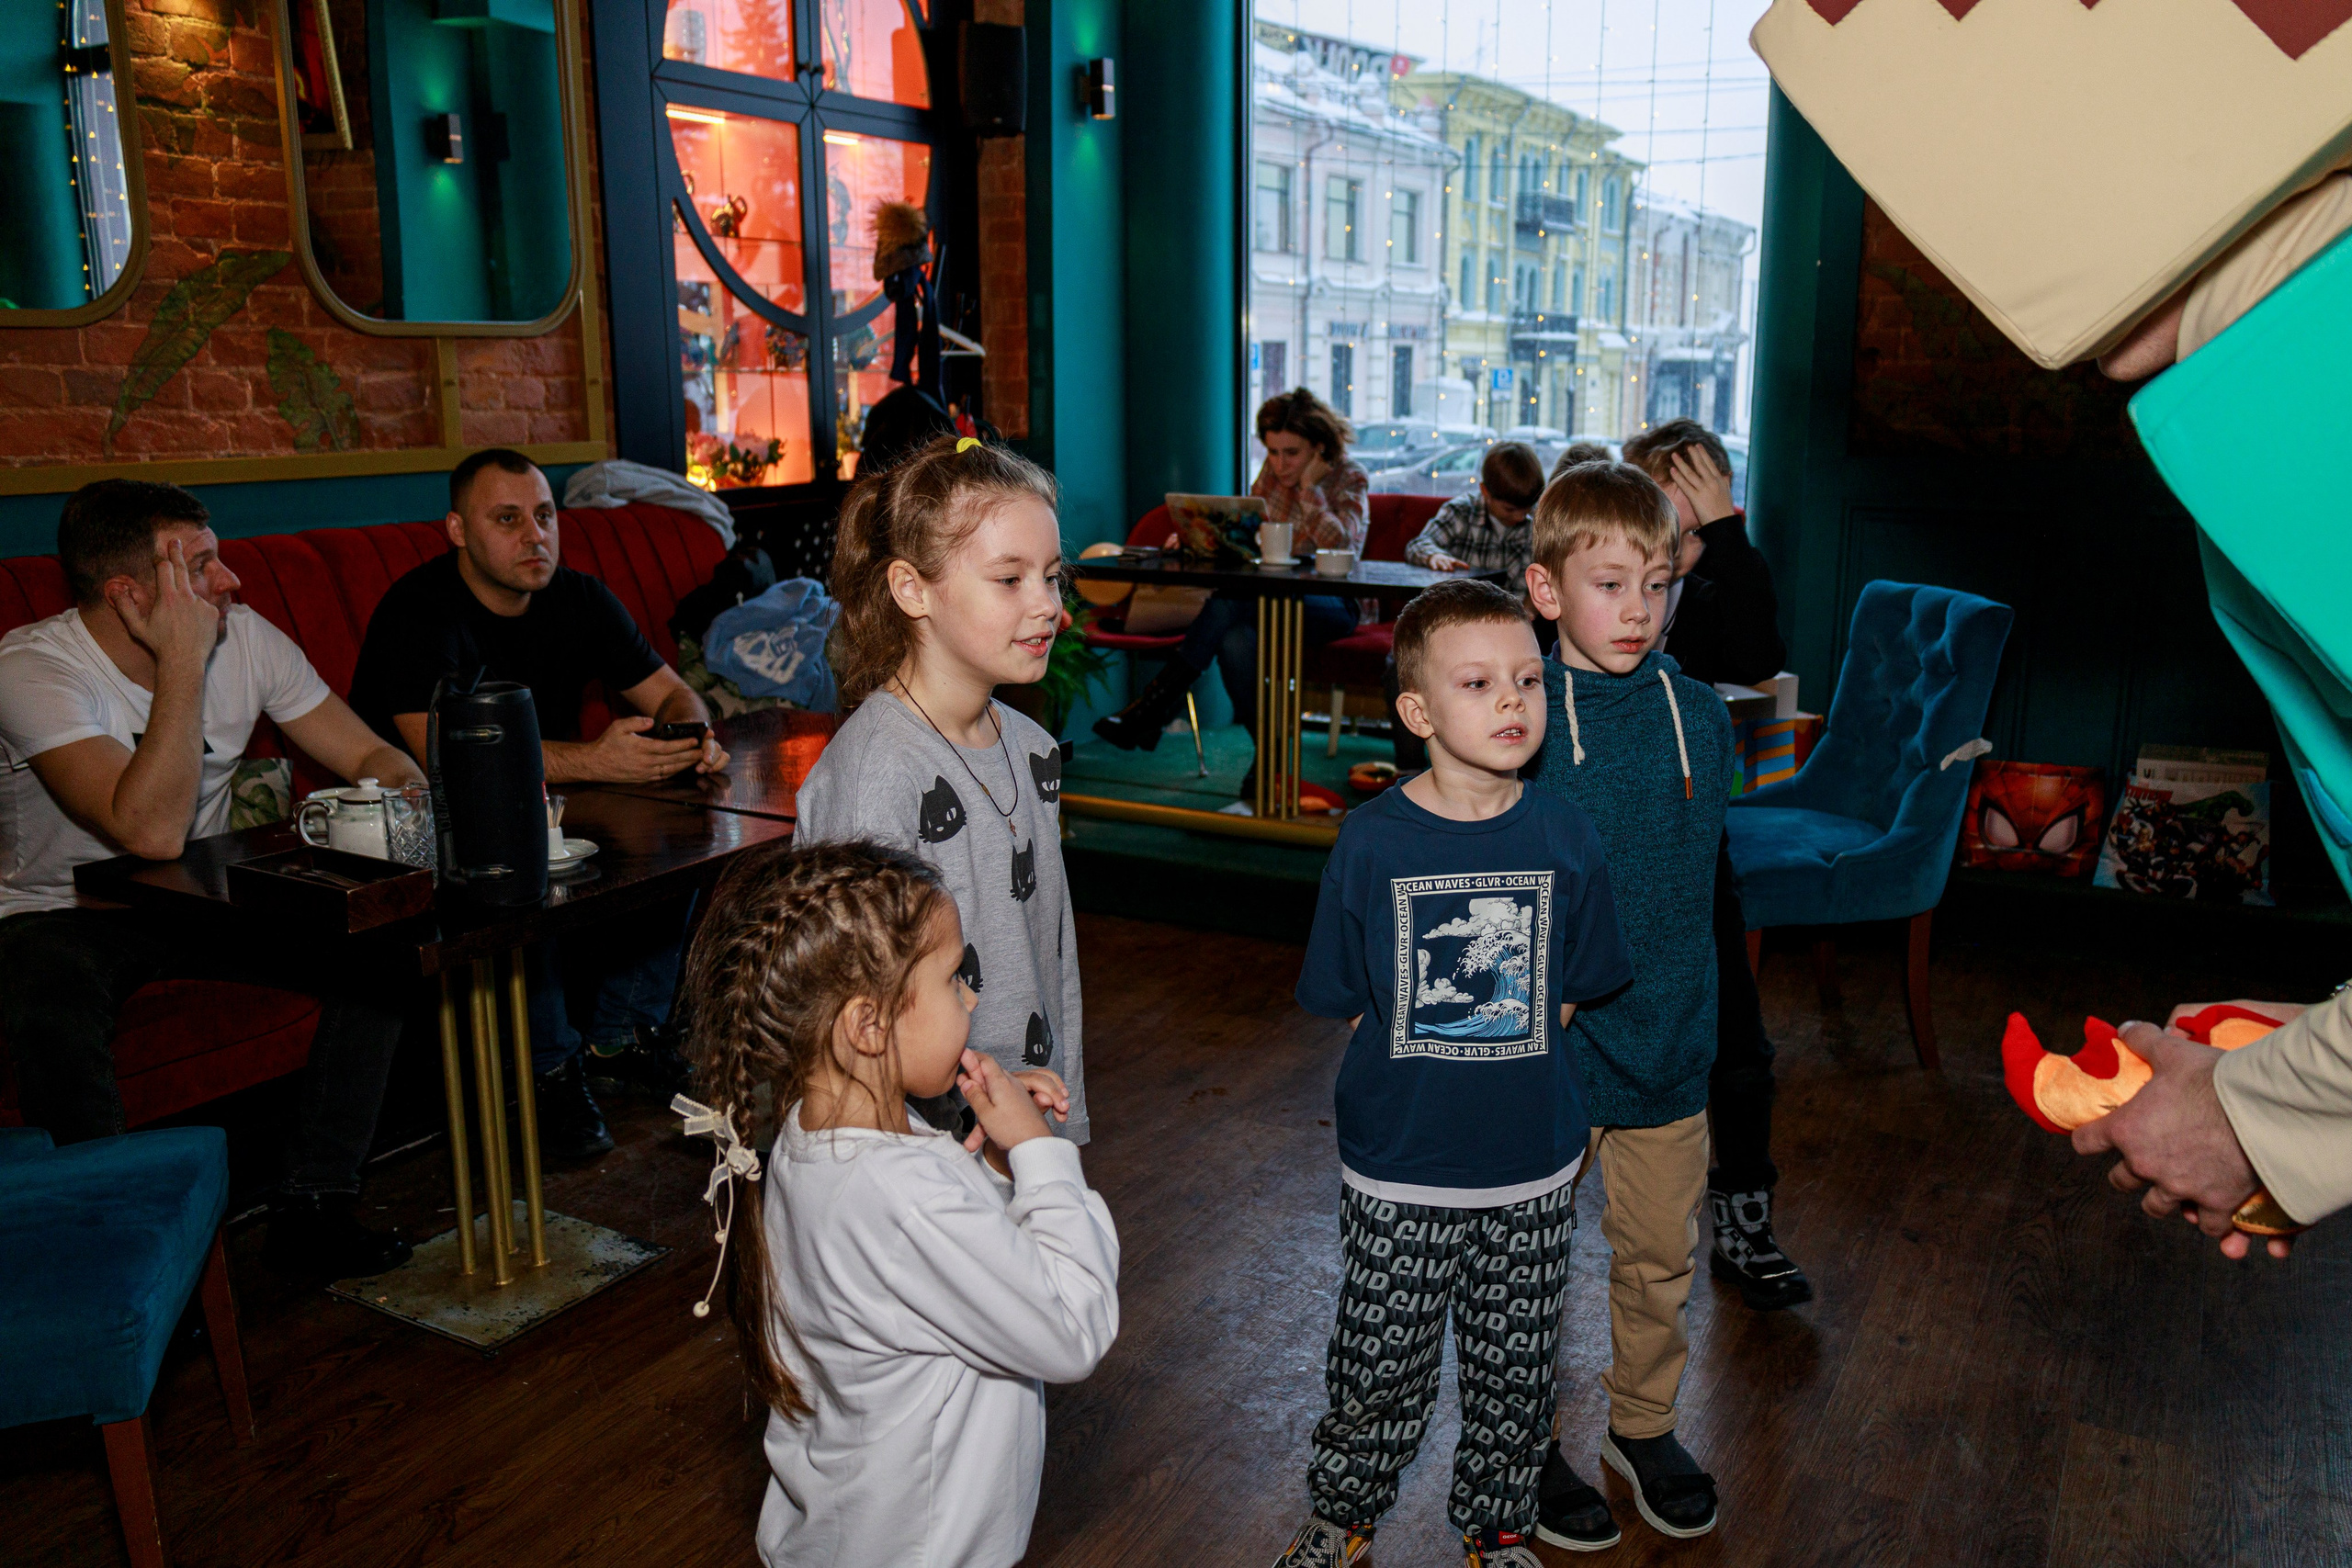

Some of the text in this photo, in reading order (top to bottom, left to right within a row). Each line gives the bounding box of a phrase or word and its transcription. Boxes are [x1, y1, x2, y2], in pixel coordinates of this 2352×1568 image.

[1434, 878, 1470, 890] WAVES
[1475, 876, 1501, 887] GLVR
[1505, 875, 1536, 886] OCEAN
[1541, 881, 1550, 915] OCEAN
[1397, 898, 1408, 932] OCEAN
[1538, 917, 1548, 951] WAVES
[1399, 937, 1408, 964] GLVR
[1399, 968, 1408, 1003] WAVES
[1536, 985, 1544, 1017] OCEAN
[1396, 1003, 1407, 1031] OCEAN
[1428, 1043, 1459, 1055] OCEAN
[1464, 1046, 1490, 1056] GLVR
[1495, 1044, 1525, 1056] WAVES
